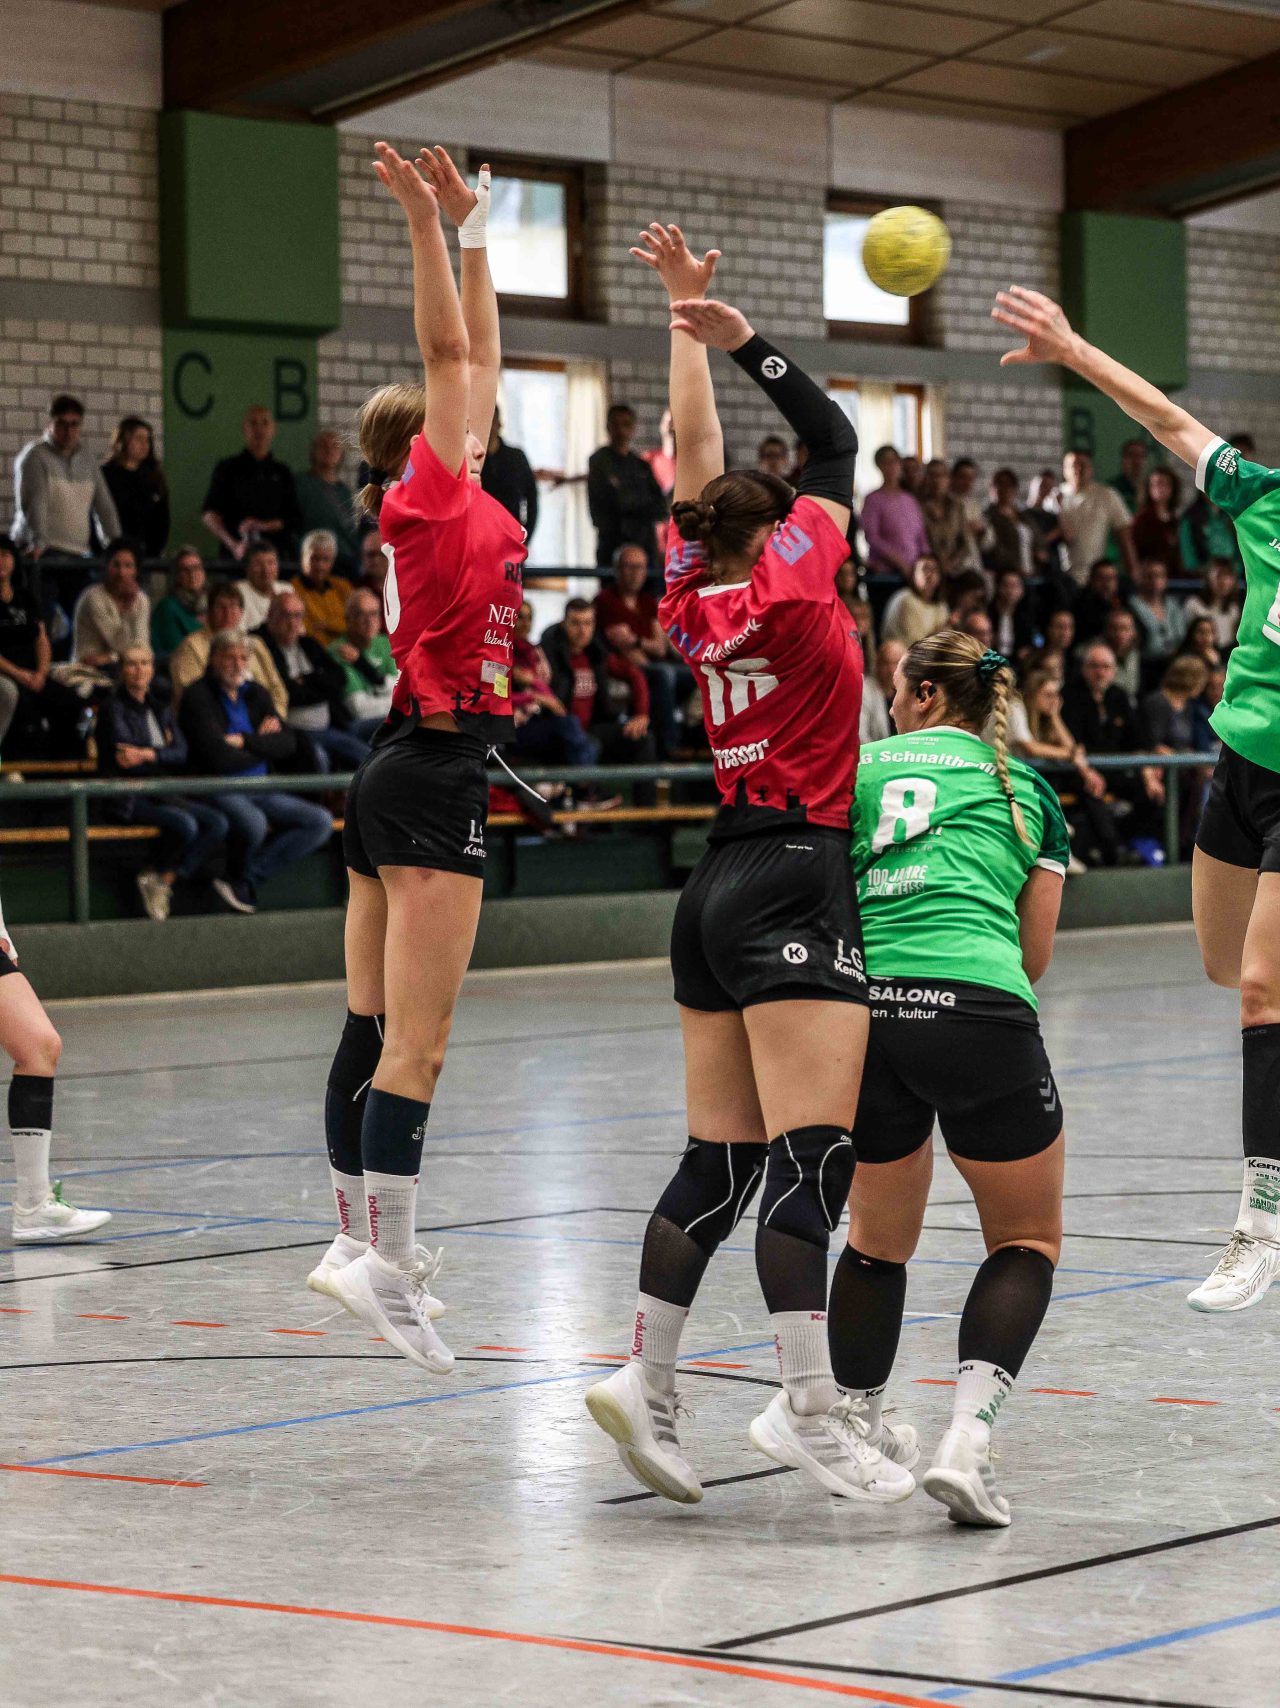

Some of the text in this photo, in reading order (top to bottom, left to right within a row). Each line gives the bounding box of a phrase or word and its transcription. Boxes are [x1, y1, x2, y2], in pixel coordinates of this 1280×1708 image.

[173, 352, 214, 420] C
[273, 358, 309, 421] B
[872, 777, 938, 855] 8
[866, 868, 889, 888] 100
[868, 985, 957, 1008] SALONG
[897, 1005, 938, 1020] kultur
[630, 1310, 648, 1358] Kempa
